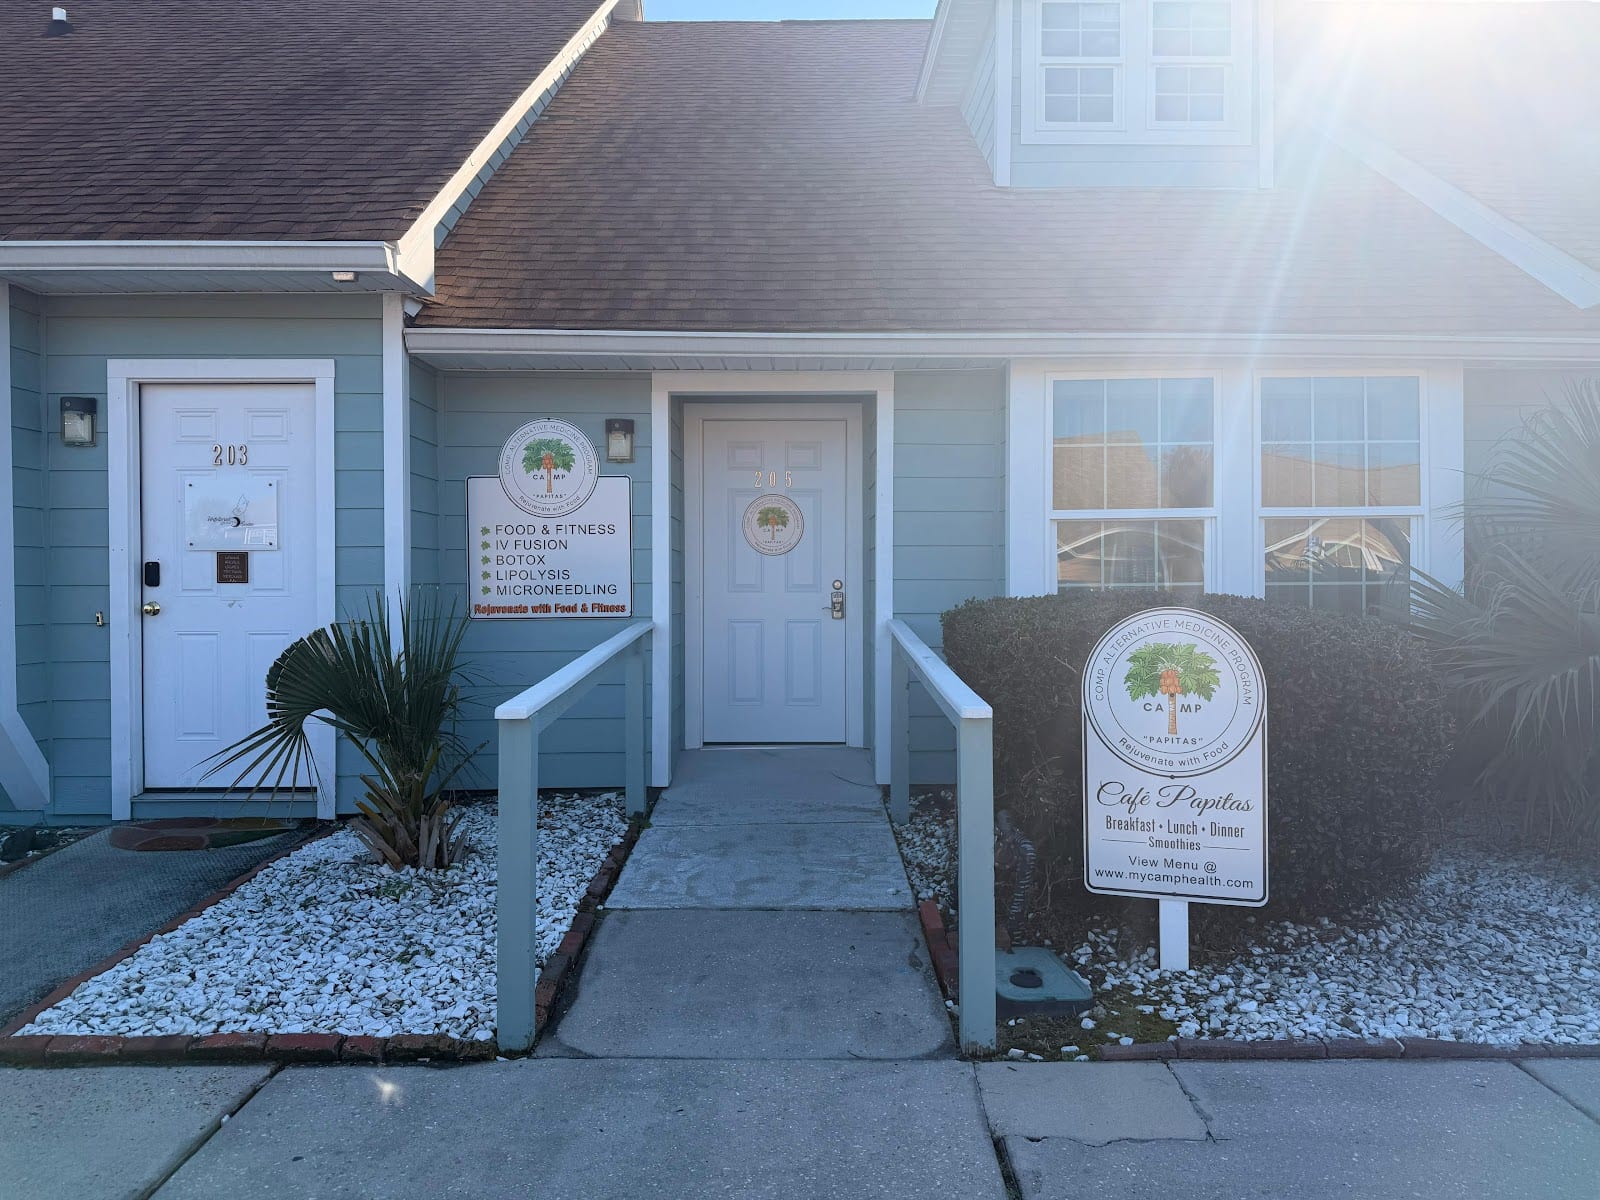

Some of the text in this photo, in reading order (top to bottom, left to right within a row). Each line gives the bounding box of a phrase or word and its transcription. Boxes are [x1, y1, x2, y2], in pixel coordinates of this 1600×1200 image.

[212, 444, 248, 466] 203
[510, 425, 547, 452] ALTERNATIVE
[550, 425, 581, 443] MEDICINE
[580, 442, 593, 475] PROGRAM
[754, 471, 792, 488] 205
[495, 524, 616, 536] FOOD & FITNESS
[496, 540, 568, 550] IV FUSION
[496, 555, 546, 566] BOTOX
[496, 570, 570, 581] LIPOLYSIS
[497, 584, 617, 596] MICRONEEDLING
[474, 603, 627, 616] Rejuvenate with Food & Fitness
[1104, 620, 1170, 665] ALTERNATIVE
[1175, 620, 1231, 650] MEDICINE
[1228, 650, 1252, 705] PROGRAM
[1119, 737, 1229, 767] Rejuvenate with Food
[1096, 780, 1254, 817] Café Papitas
[1106, 815, 1245, 839] Breakfast Lunch Dinner
[1148, 836, 1201, 851] Smoothies
[1128, 855, 1217, 874] View Menu @
[1094, 869, 1254, 889] www.mycamphealth.com
